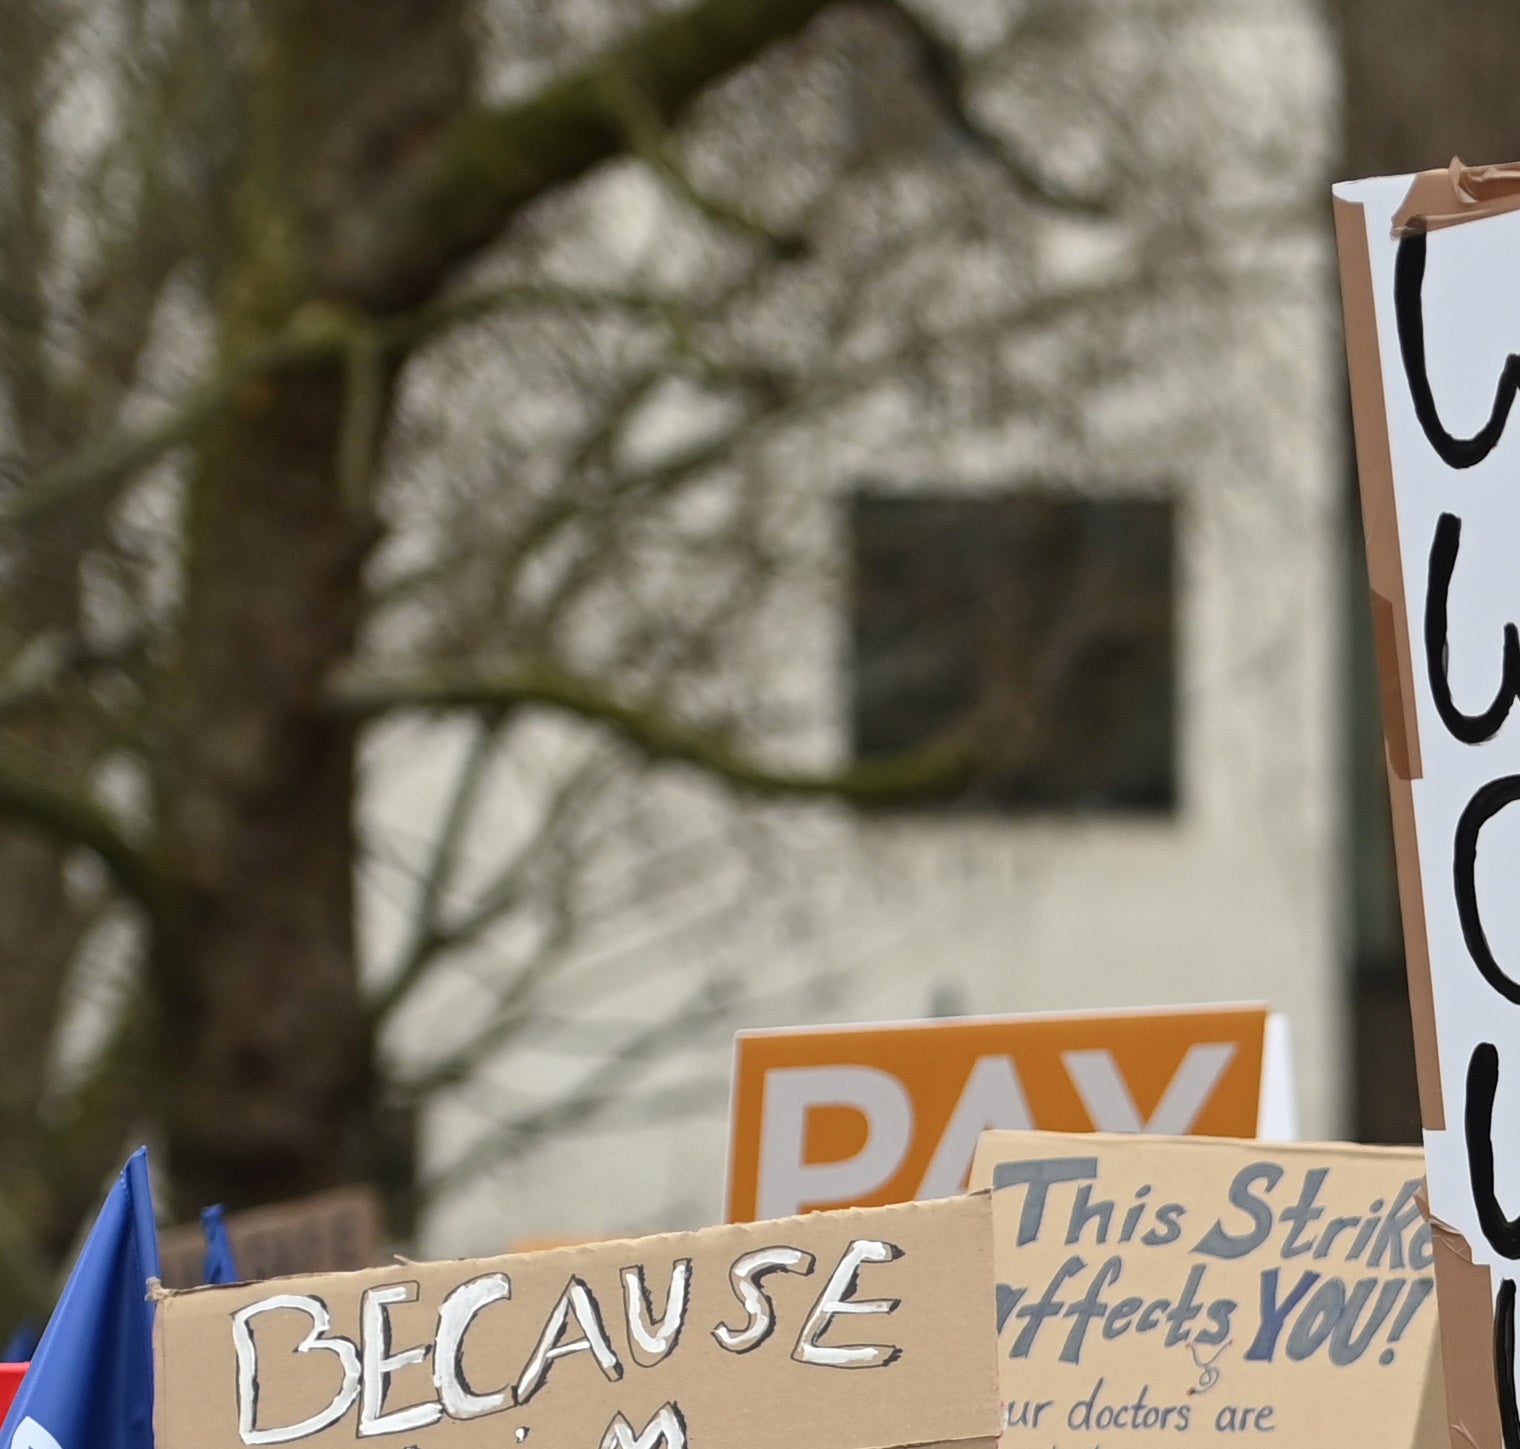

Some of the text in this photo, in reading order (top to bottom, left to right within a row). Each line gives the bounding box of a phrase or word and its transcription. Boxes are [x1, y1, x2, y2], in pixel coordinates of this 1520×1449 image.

[993, 1155, 1188, 1248] This
[231, 1239, 906, 1446] BECAUSE
[1243, 1265, 1434, 1367] YOU!
[1066, 1376, 1191, 1432] doctors
[1214, 1403, 1277, 1434] are
